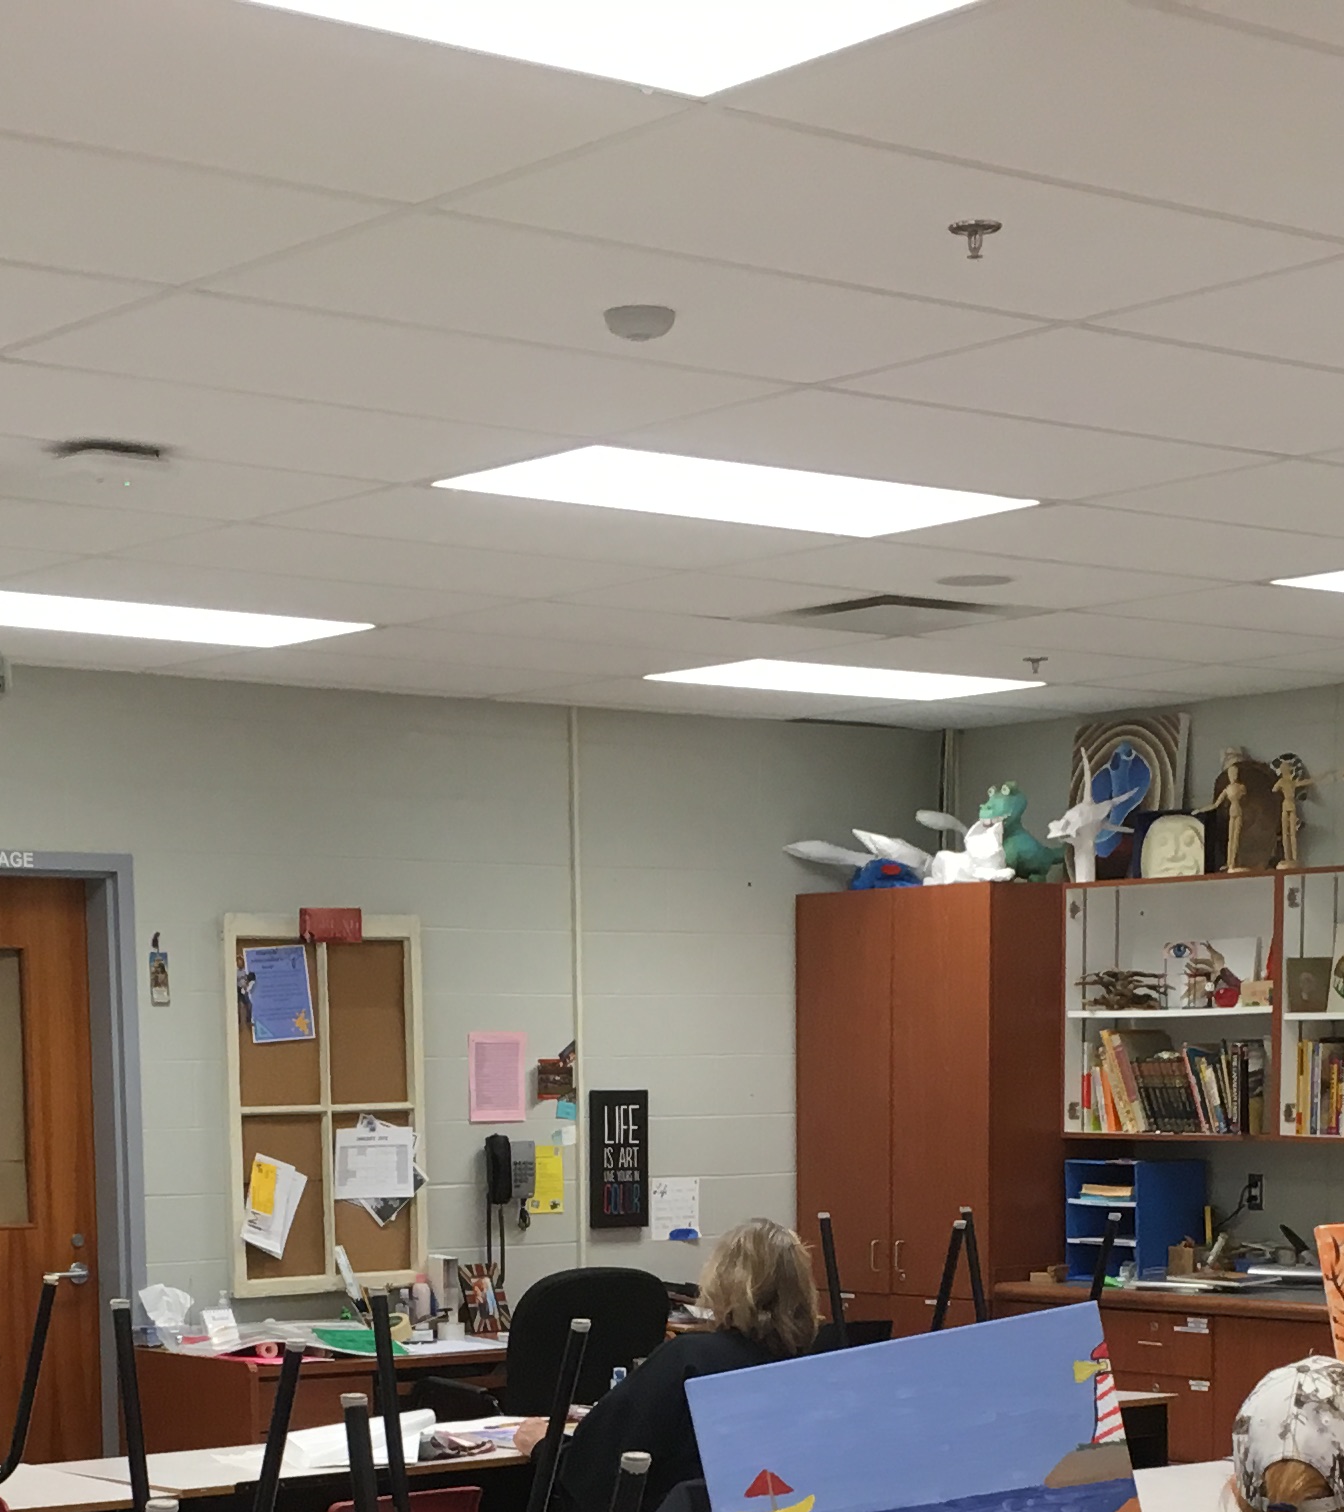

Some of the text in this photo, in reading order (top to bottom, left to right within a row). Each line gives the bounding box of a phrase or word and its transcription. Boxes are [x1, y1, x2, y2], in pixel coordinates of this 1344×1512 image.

[604, 1104, 640, 1144] LIFE
[604, 1147, 639, 1168] IS ART
